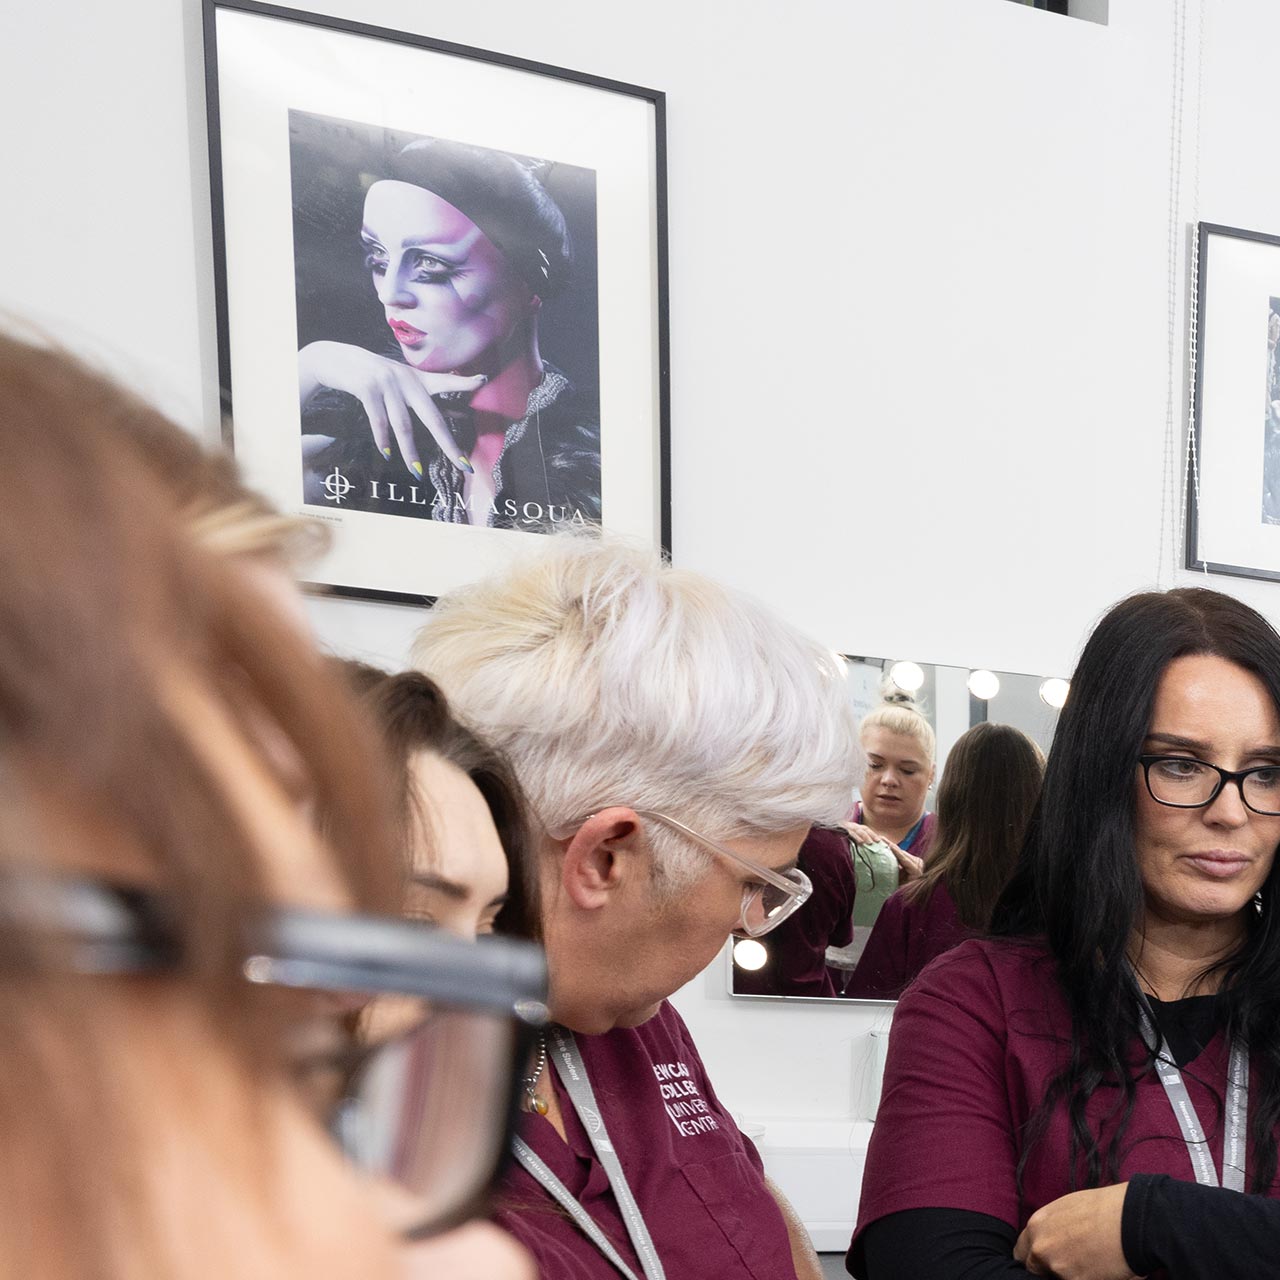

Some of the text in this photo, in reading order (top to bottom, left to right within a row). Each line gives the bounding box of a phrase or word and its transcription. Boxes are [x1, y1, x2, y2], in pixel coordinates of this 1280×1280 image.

[368, 479, 587, 525] ILLAMASQUA
[561, 1051, 580, 1082] Student
[525, 1155, 550, 1181] Centre
[1198, 1152, 1211, 1183] University
[629, 1215, 647, 1246] College
